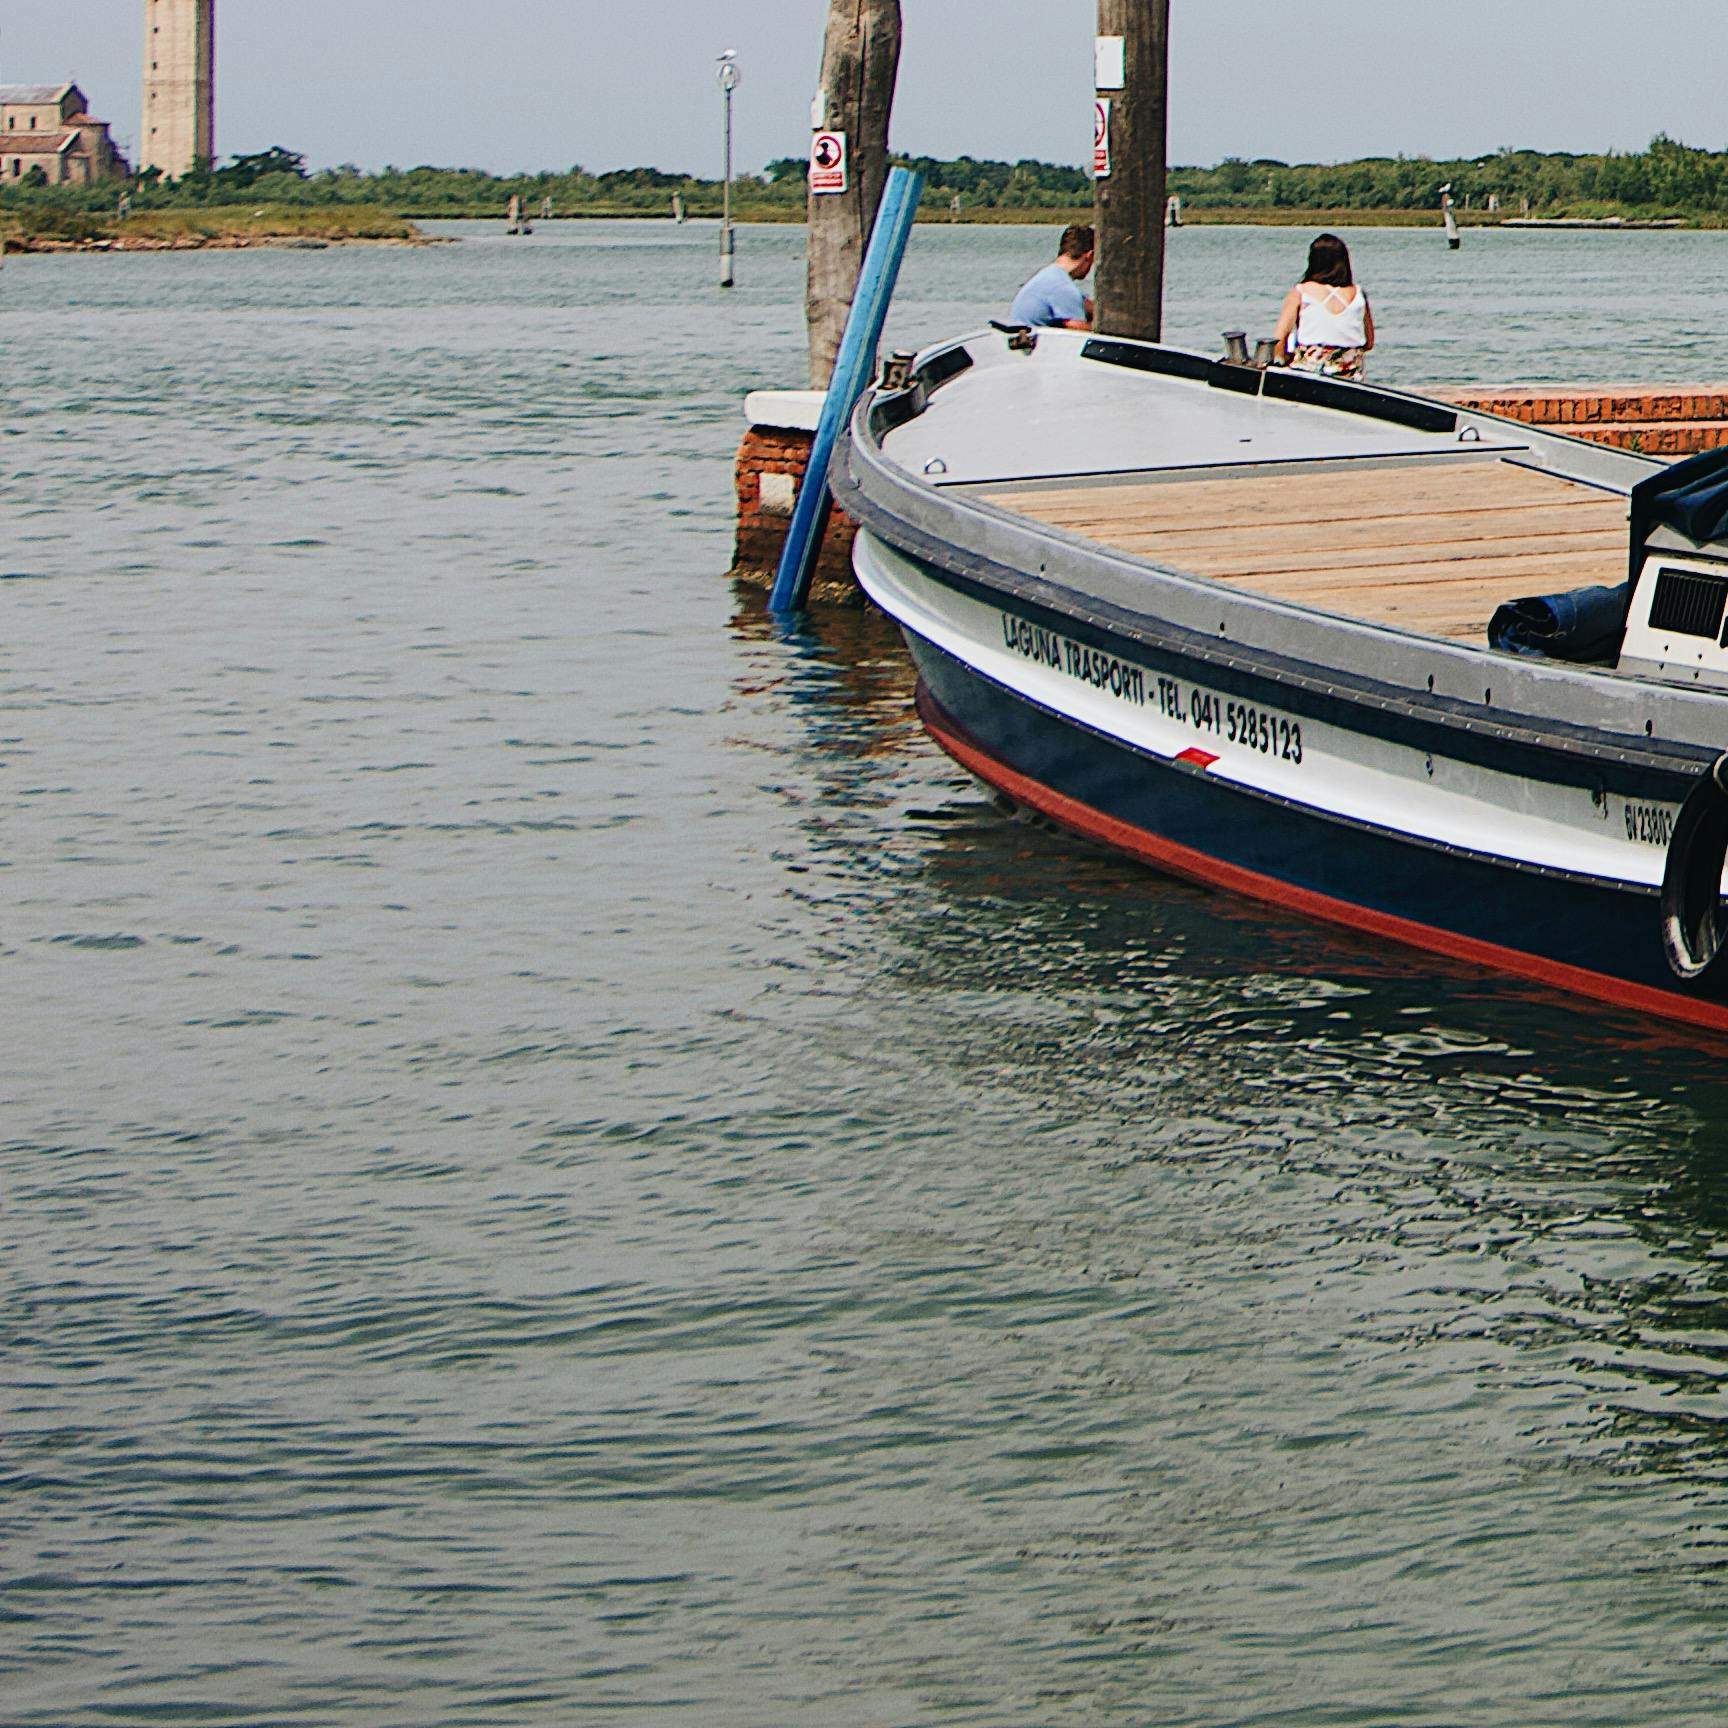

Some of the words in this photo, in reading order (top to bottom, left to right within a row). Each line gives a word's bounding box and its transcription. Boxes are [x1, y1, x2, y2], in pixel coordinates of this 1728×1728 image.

[1002, 612, 1062, 671] LAGUNA
[1064, 640, 1145, 706] TRASPORTI
[1158, 677, 1187, 723] TEL.
[1191, 688, 1221, 735] 041
[1226, 702, 1303, 765] 5285123
